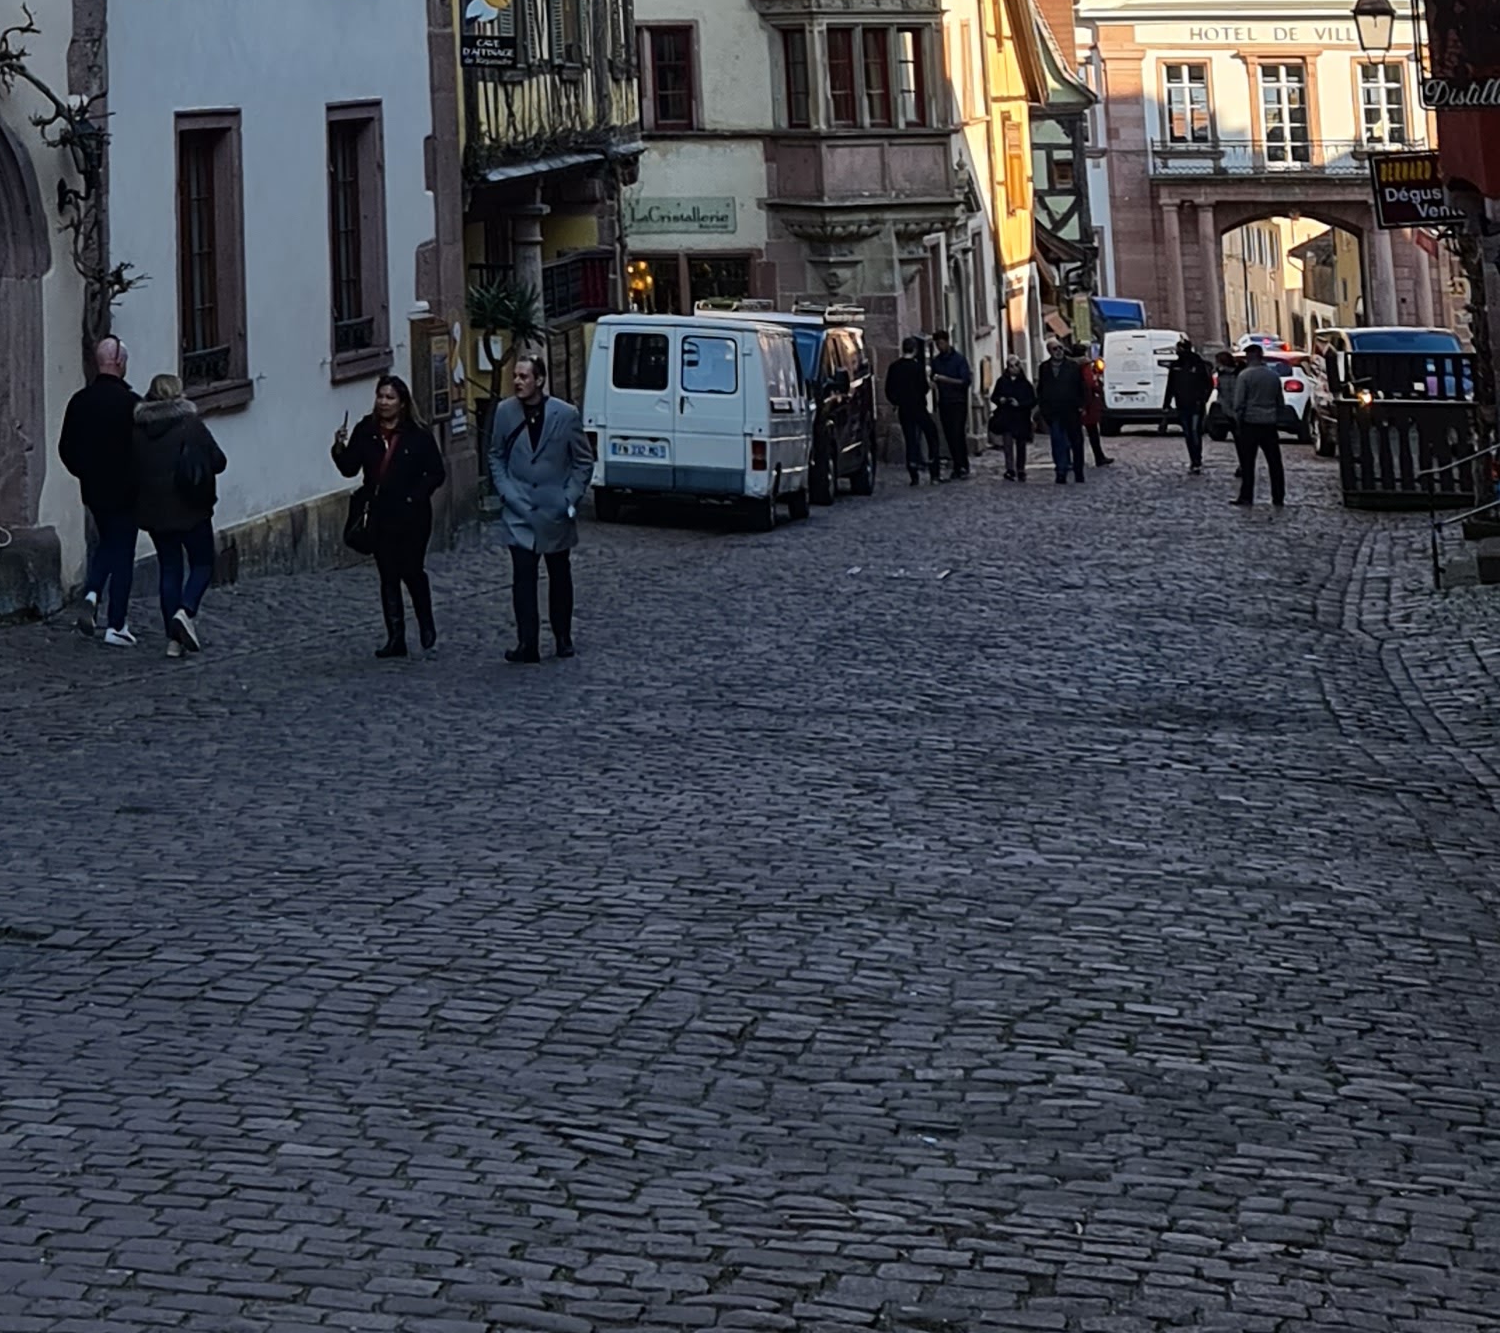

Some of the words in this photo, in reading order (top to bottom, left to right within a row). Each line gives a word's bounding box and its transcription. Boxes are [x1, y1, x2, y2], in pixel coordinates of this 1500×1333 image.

[1189, 26, 1258, 42] HOTEL
[1273, 26, 1300, 42] DE
[1313, 26, 1355, 42] VILL
